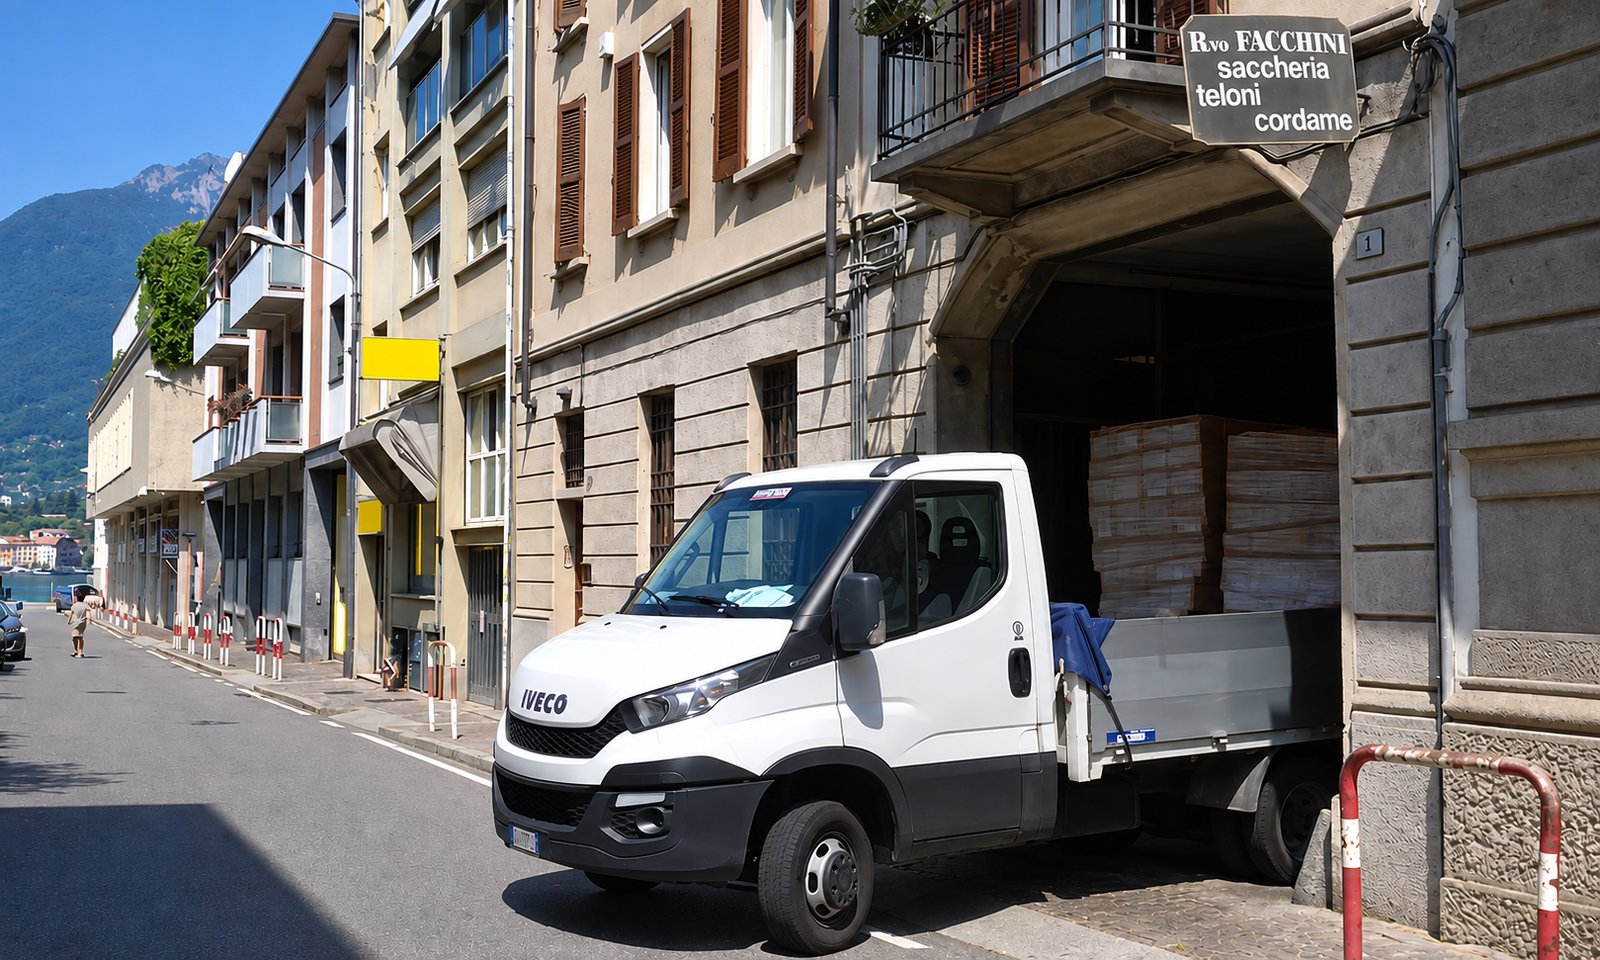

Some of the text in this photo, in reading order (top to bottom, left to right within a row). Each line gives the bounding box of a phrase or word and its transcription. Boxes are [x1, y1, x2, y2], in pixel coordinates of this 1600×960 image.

[1235, 30, 1347, 54] FACCHINI
[1218, 55, 1329, 79] saccheria
[1196, 83, 1261, 106] teloni
[1255, 108, 1352, 131] cordame
[1364, 235, 1371, 251] 1
[521, 689, 567, 714] IVECO
